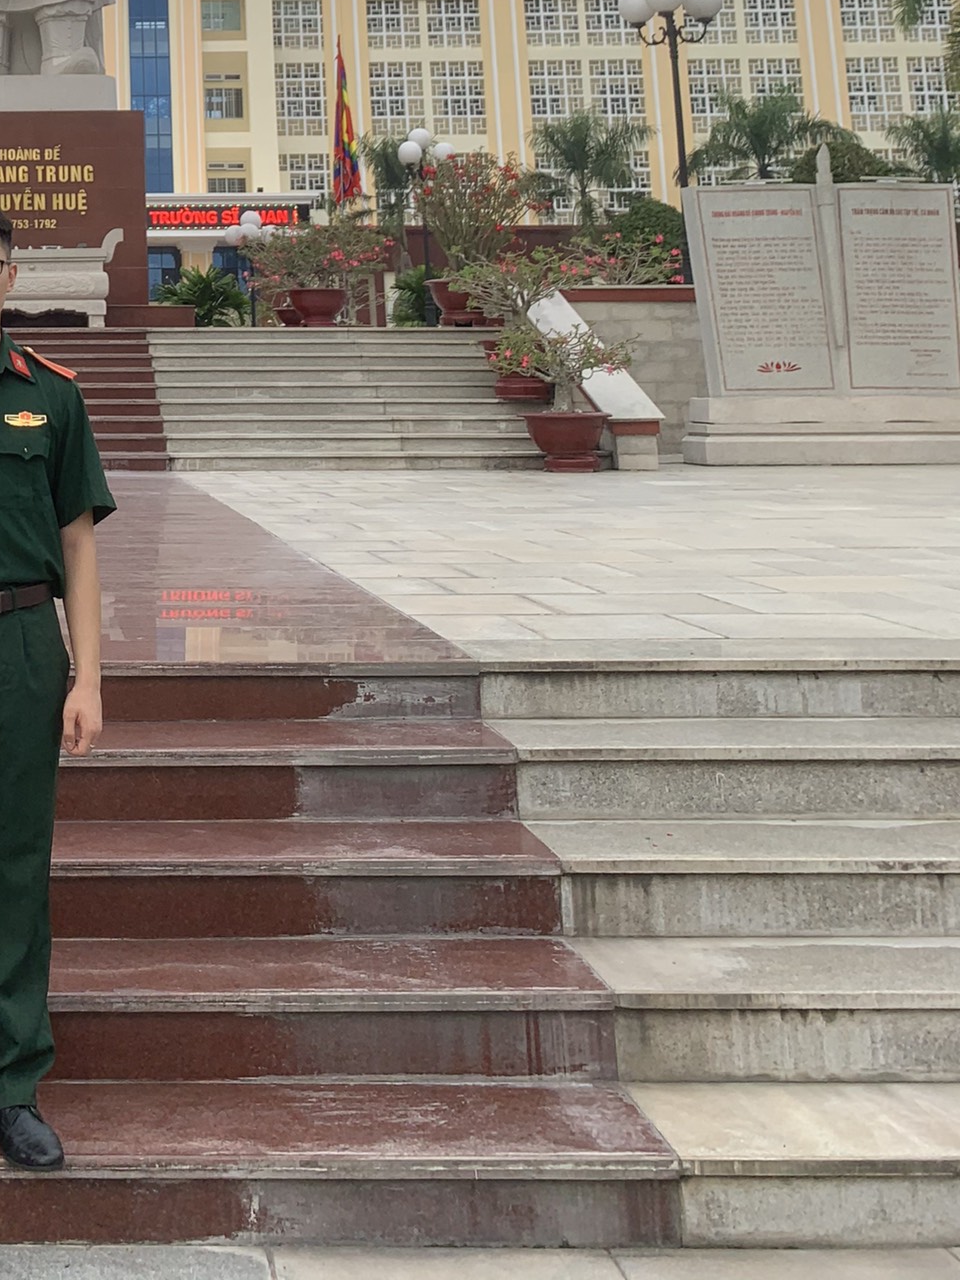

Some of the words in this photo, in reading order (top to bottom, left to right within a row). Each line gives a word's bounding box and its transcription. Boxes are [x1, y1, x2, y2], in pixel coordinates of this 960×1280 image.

[0, 145, 41, 161] HOÀNG
[44, 144, 61, 161] ĐẾ
[35, 164, 94, 183] TRUNG
[52, 189, 88, 215] HUỆ
[11, 218, 57, 229] 753-1792
[149, 207, 218, 225] TRƯỜNG
[221, 206, 239, 225] SĨ
[255, 209, 289, 225] UAN
